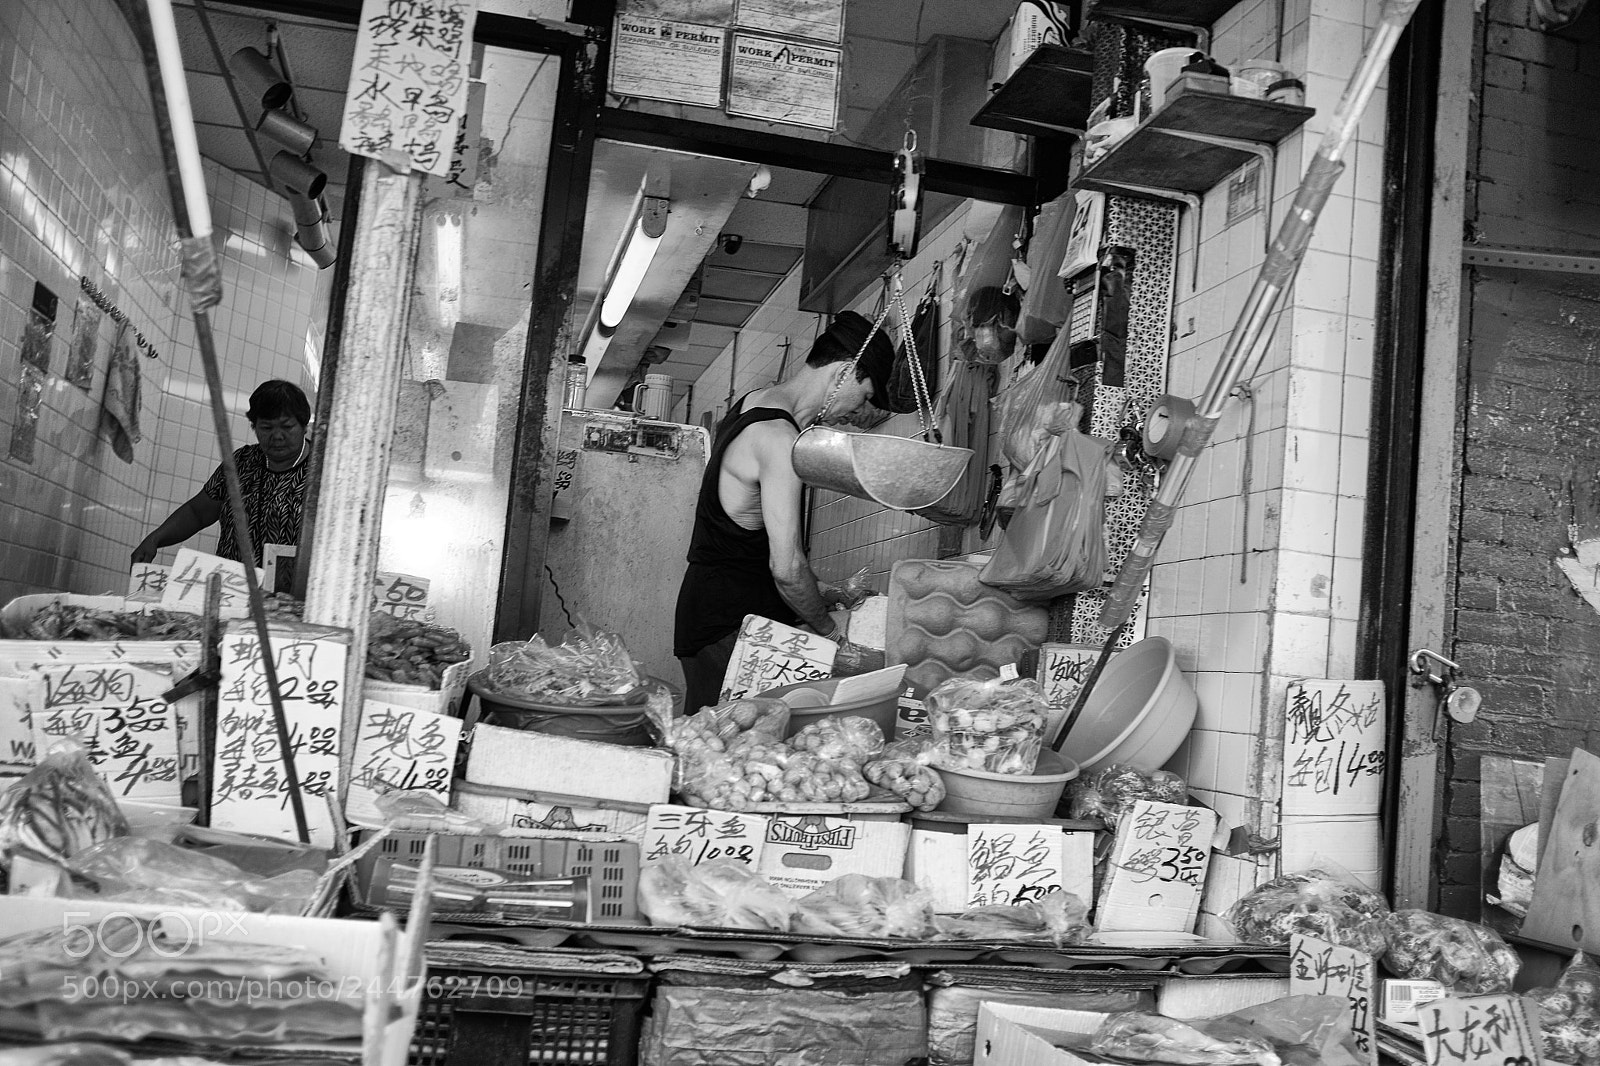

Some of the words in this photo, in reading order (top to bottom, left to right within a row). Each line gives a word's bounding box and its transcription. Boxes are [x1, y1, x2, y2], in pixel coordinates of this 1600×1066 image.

[621, 23, 656, 35] WORK
[675, 31, 721, 44] PERMIT
[738, 45, 772, 58] WORK
[791, 54, 835, 68] PERMIT
